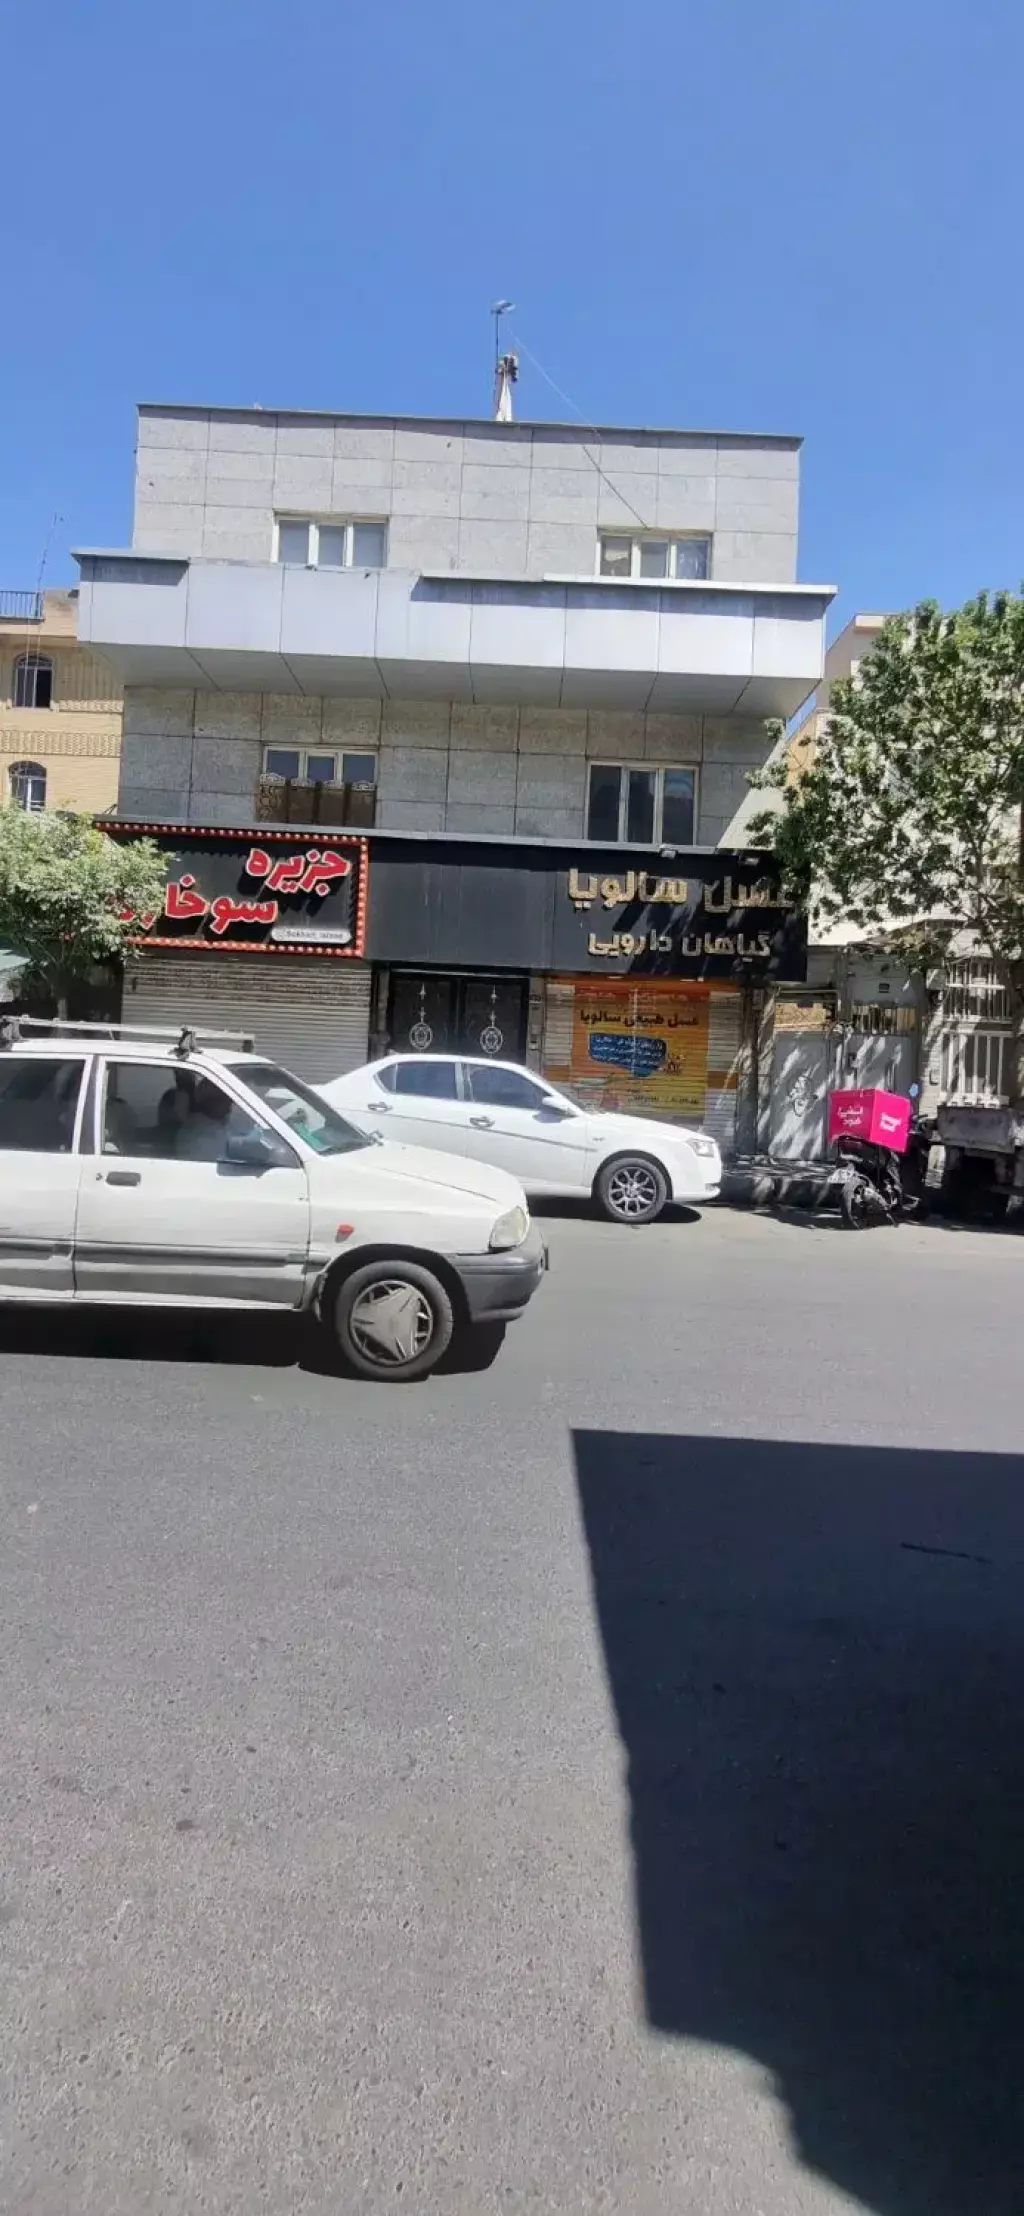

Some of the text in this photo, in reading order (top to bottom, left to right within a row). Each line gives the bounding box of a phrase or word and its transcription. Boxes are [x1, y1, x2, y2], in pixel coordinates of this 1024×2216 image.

[246, 848, 351, 896] جزیره
[568, 868, 687, 910] سالویا
[587, 929, 772, 962] گیاهان دارویی
[580, 1009, 621, 1025] سالویا
[668, 1013, 700, 1028] عسل
